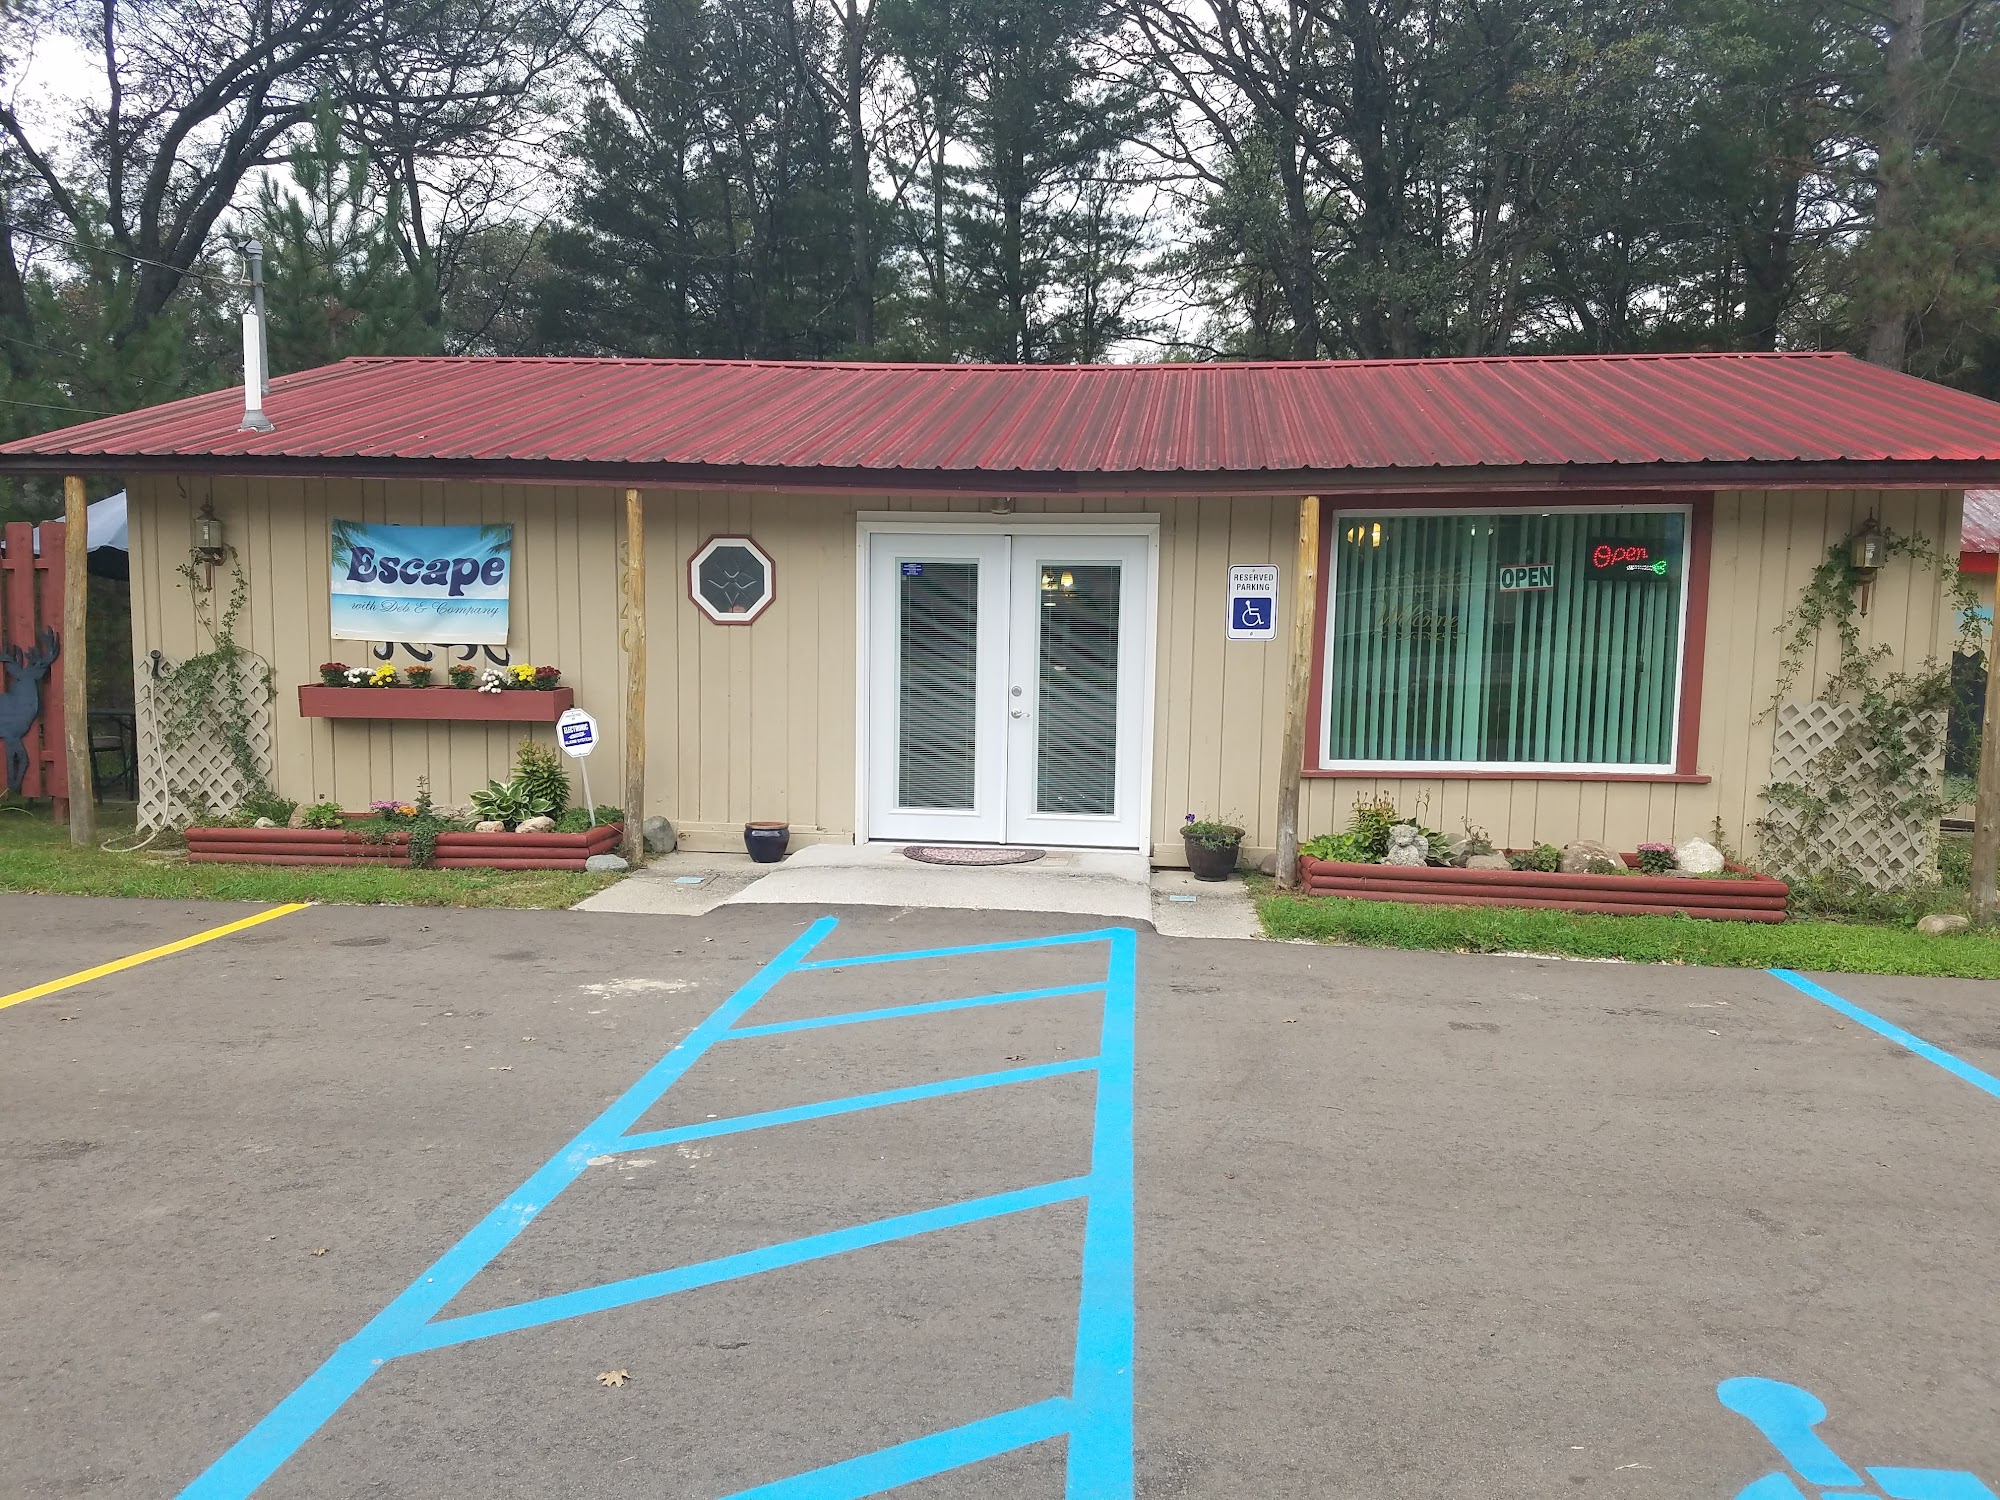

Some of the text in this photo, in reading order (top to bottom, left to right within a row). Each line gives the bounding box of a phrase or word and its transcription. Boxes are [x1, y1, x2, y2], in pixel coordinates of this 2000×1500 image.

[1593, 545, 1649, 568] Open
[346, 546, 505, 597] Escape
[1233, 573, 1274, 581] RESERVED
[1501, 566, 1552, 588] OPEN
[1236, 583, 1270, 591] PARKING
[351, 599, 500, 617] with Deb & Company
